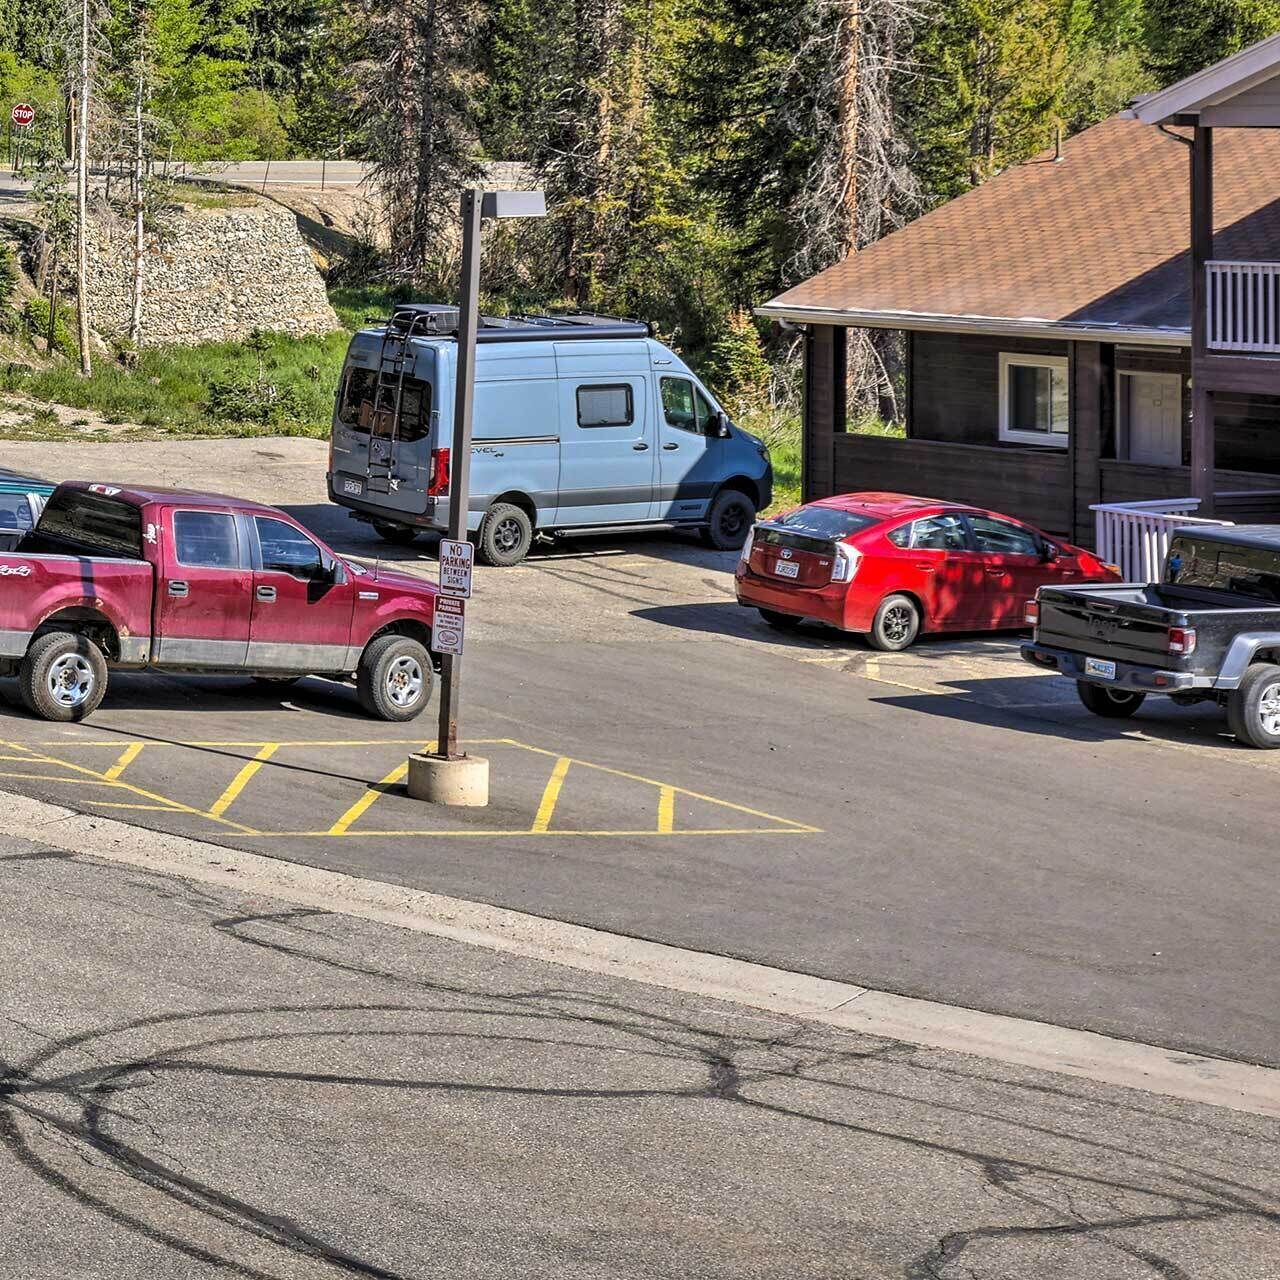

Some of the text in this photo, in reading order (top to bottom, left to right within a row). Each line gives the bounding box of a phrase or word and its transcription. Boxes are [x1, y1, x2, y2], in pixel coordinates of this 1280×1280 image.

[14, 109, 33, 119] STOP
[449, 544, 463, 557] NO
[442, 555, 470, 570] PARKING
[443, 567, 468, 577] BETWEEN
[447, 576, 463, 585] SIGNS
